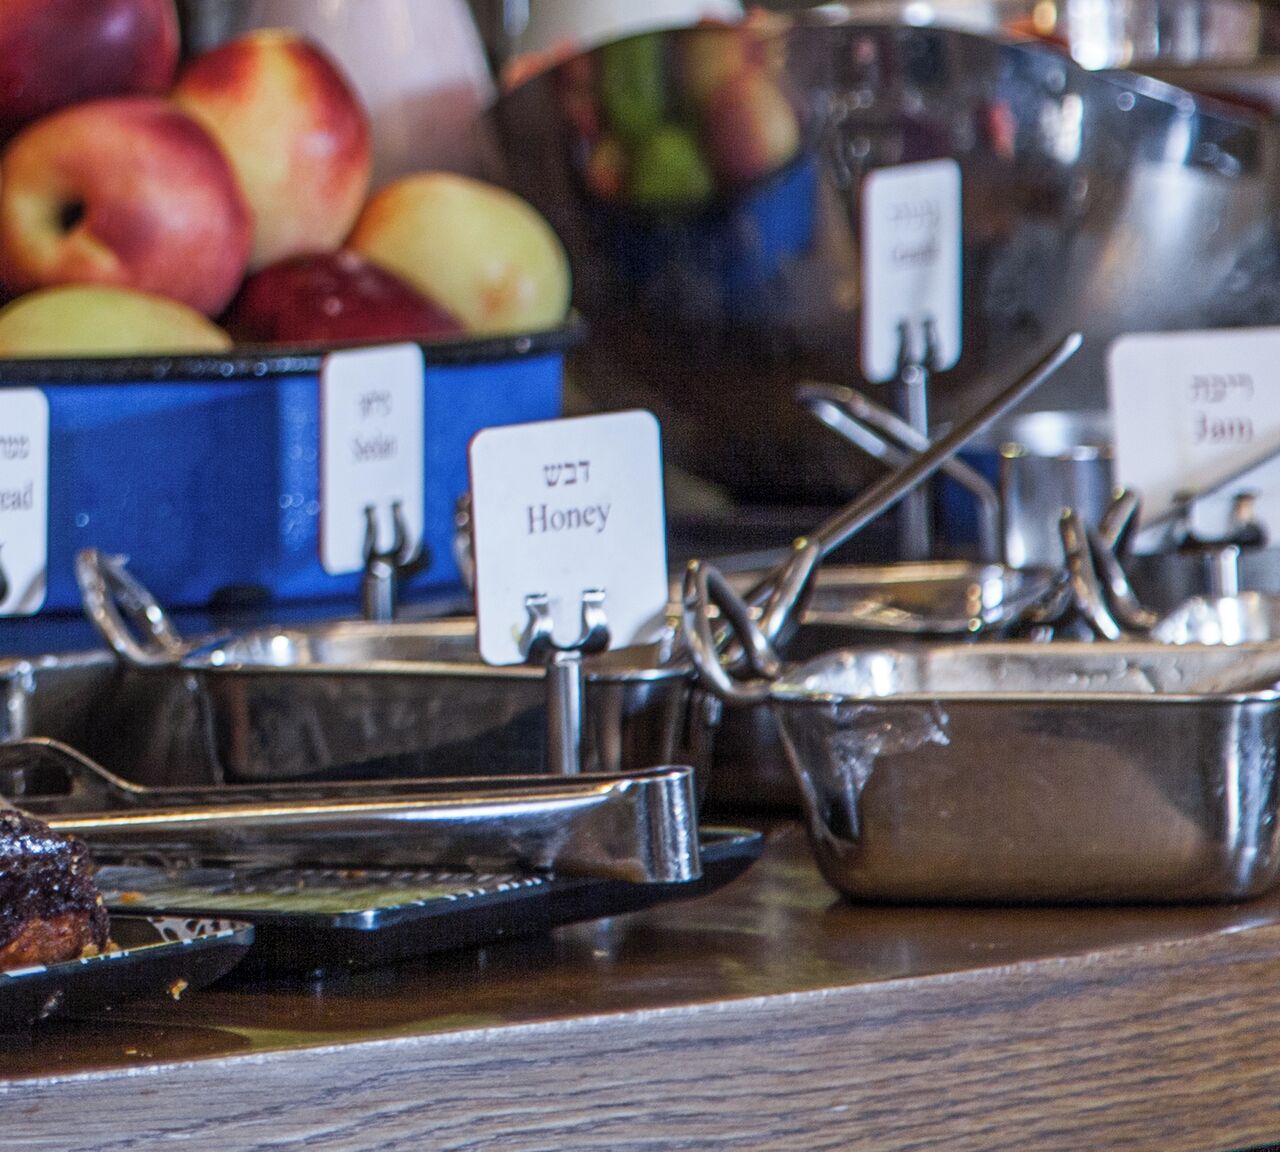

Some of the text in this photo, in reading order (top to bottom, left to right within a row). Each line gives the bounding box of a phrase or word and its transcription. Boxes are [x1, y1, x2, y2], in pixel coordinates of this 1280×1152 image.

[1196, 413, 1253, 442] Jam
[543, 460, 591, 487] דבש
[527, 503, 612, 535] Honey
